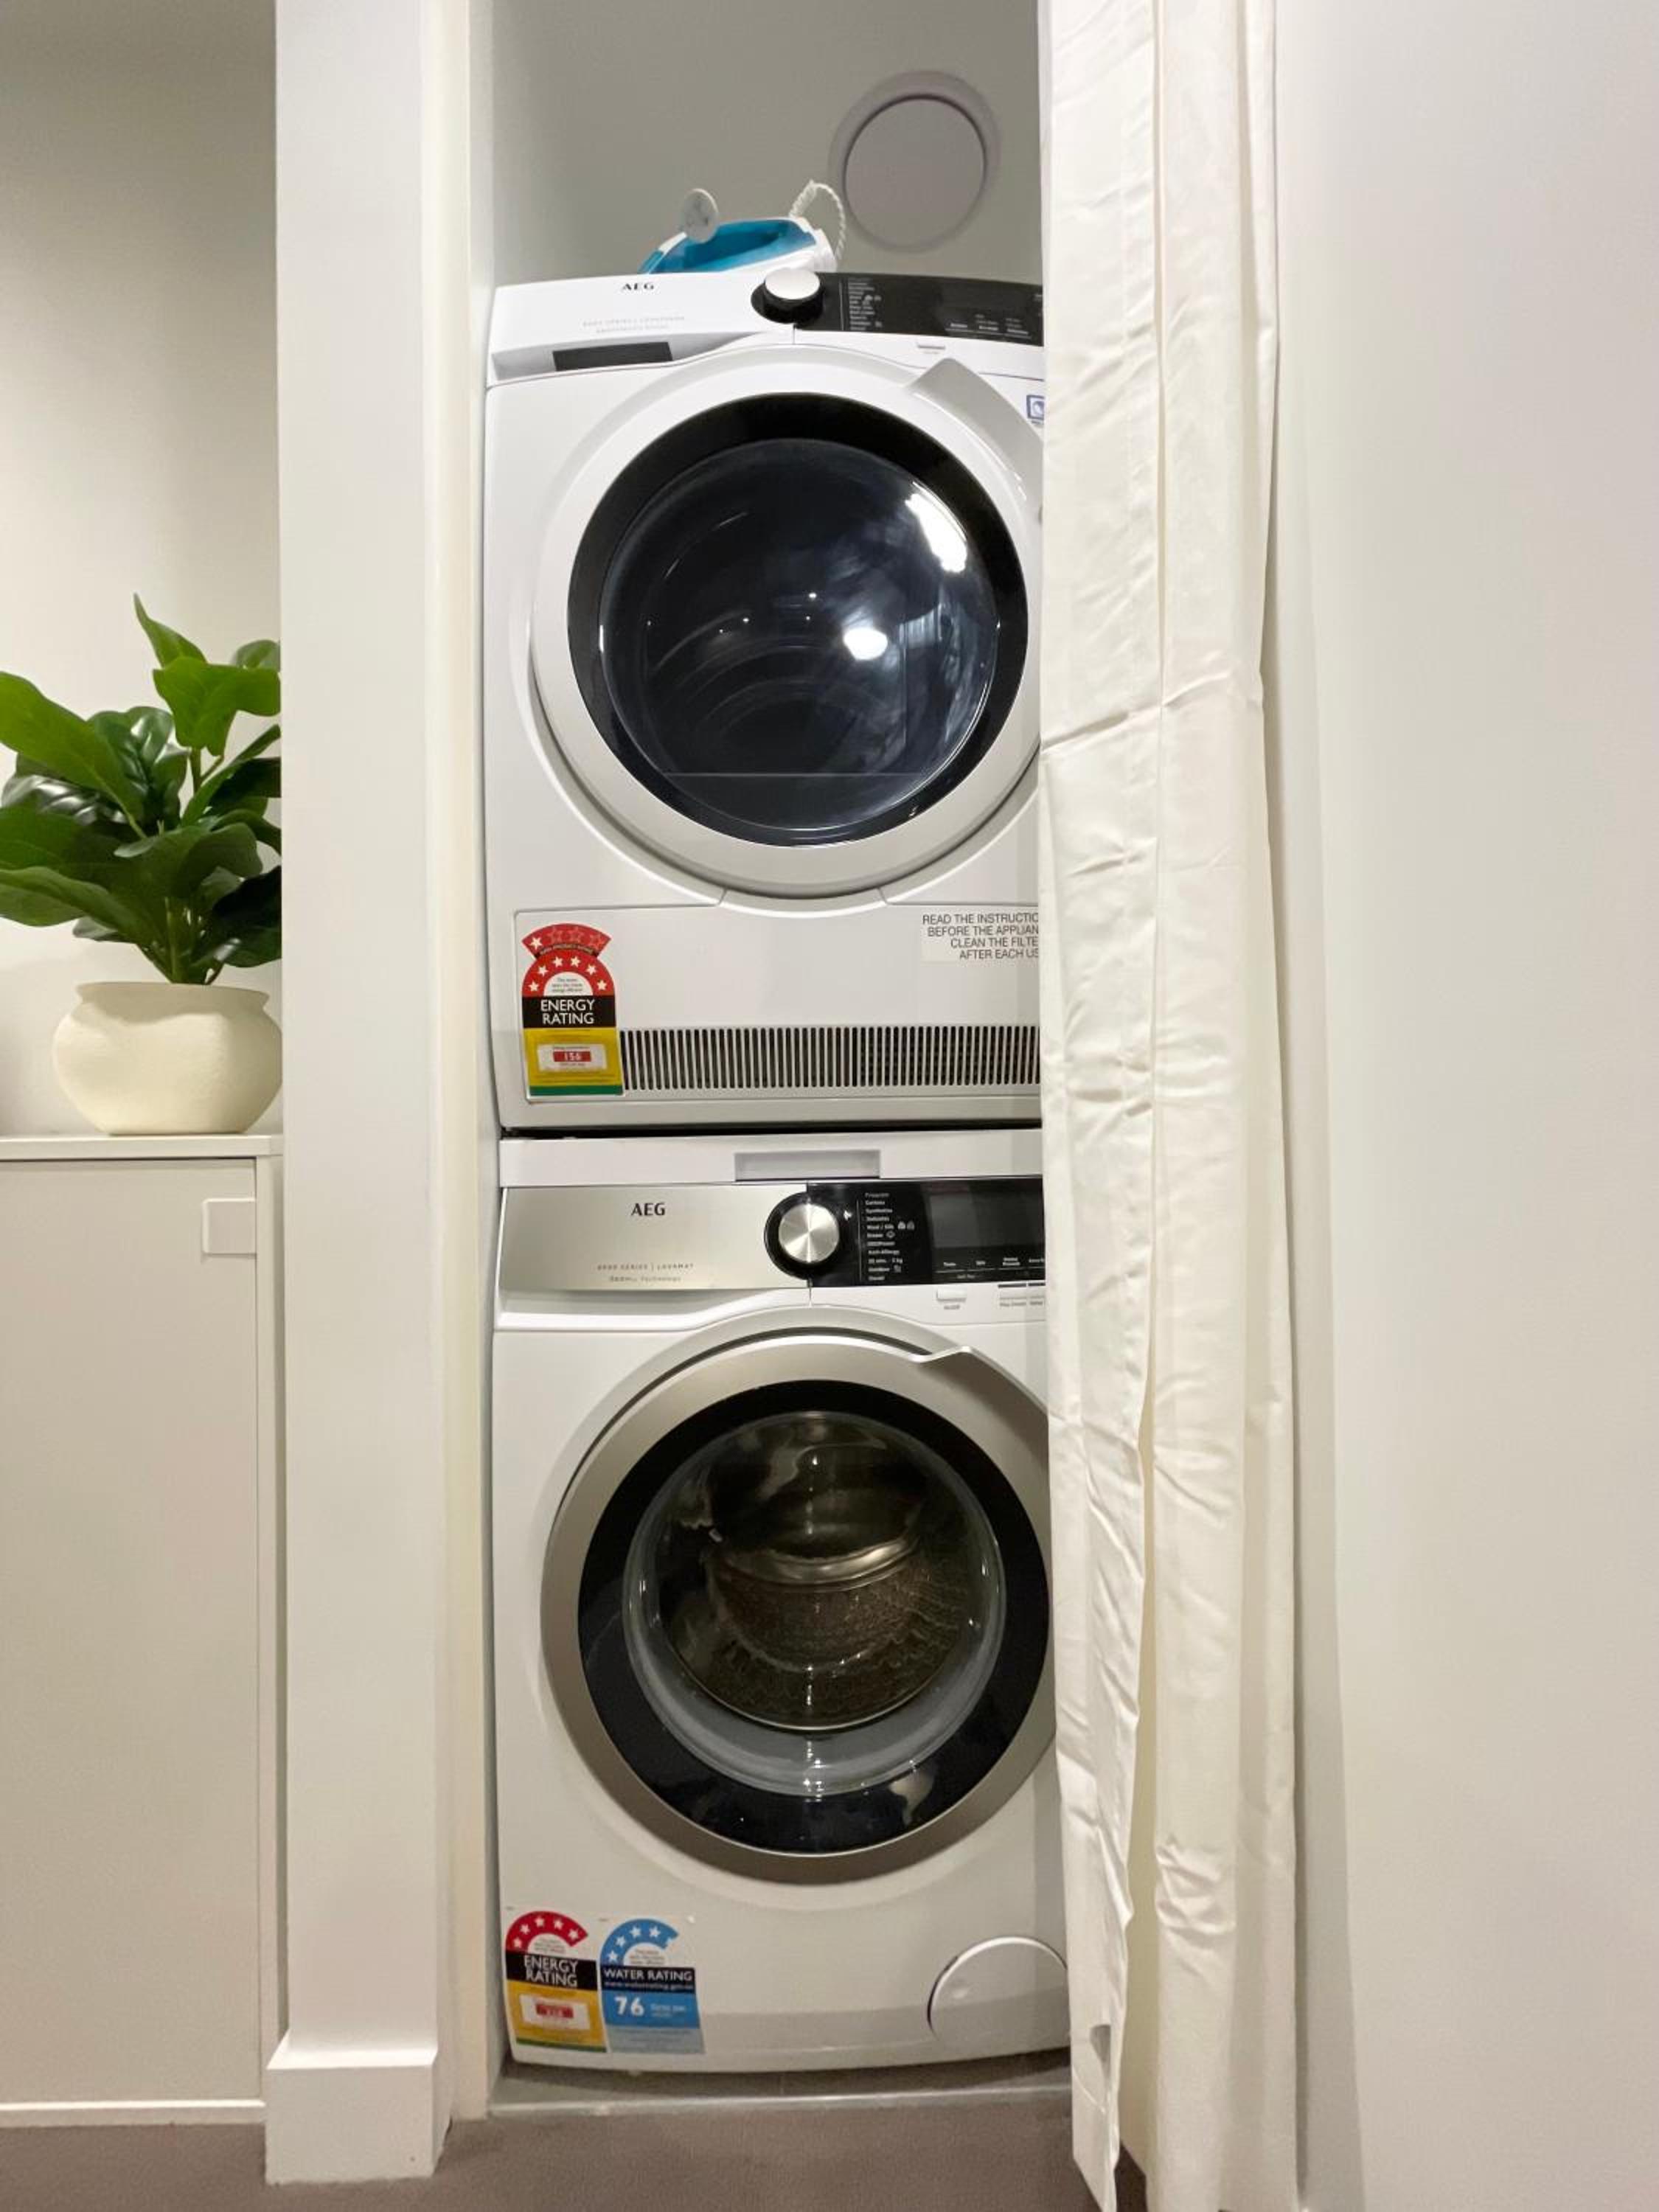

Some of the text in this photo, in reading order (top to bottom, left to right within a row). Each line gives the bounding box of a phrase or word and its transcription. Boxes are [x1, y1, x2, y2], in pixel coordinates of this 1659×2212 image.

[622, 282, 655, 291] AEG
[922, 914, 952, 925] READ
[955, 914, 976, 925] THE
[928, 925, 970, 937] BEFORE
[973, 925, 993, 936] THE
[950, 937, 986, 948] CLEAN
[988, 937, 1009, 947] THE
[959, 949, 993, 960] AFTER
[995, 948, 1023, 959] EACH
[540, 999, 595, 1012] ENERGY
[542, 1012, 595, 1025] RATING
[631, 1203, 666, 1217] AEG
[524, 1955, 579, 1974] ENERGY
[525, 1968, 578, 1987] RATING
[604, 1969, 692, 1982] WATER RATING
[614, 1995, 644, 2017] 76
